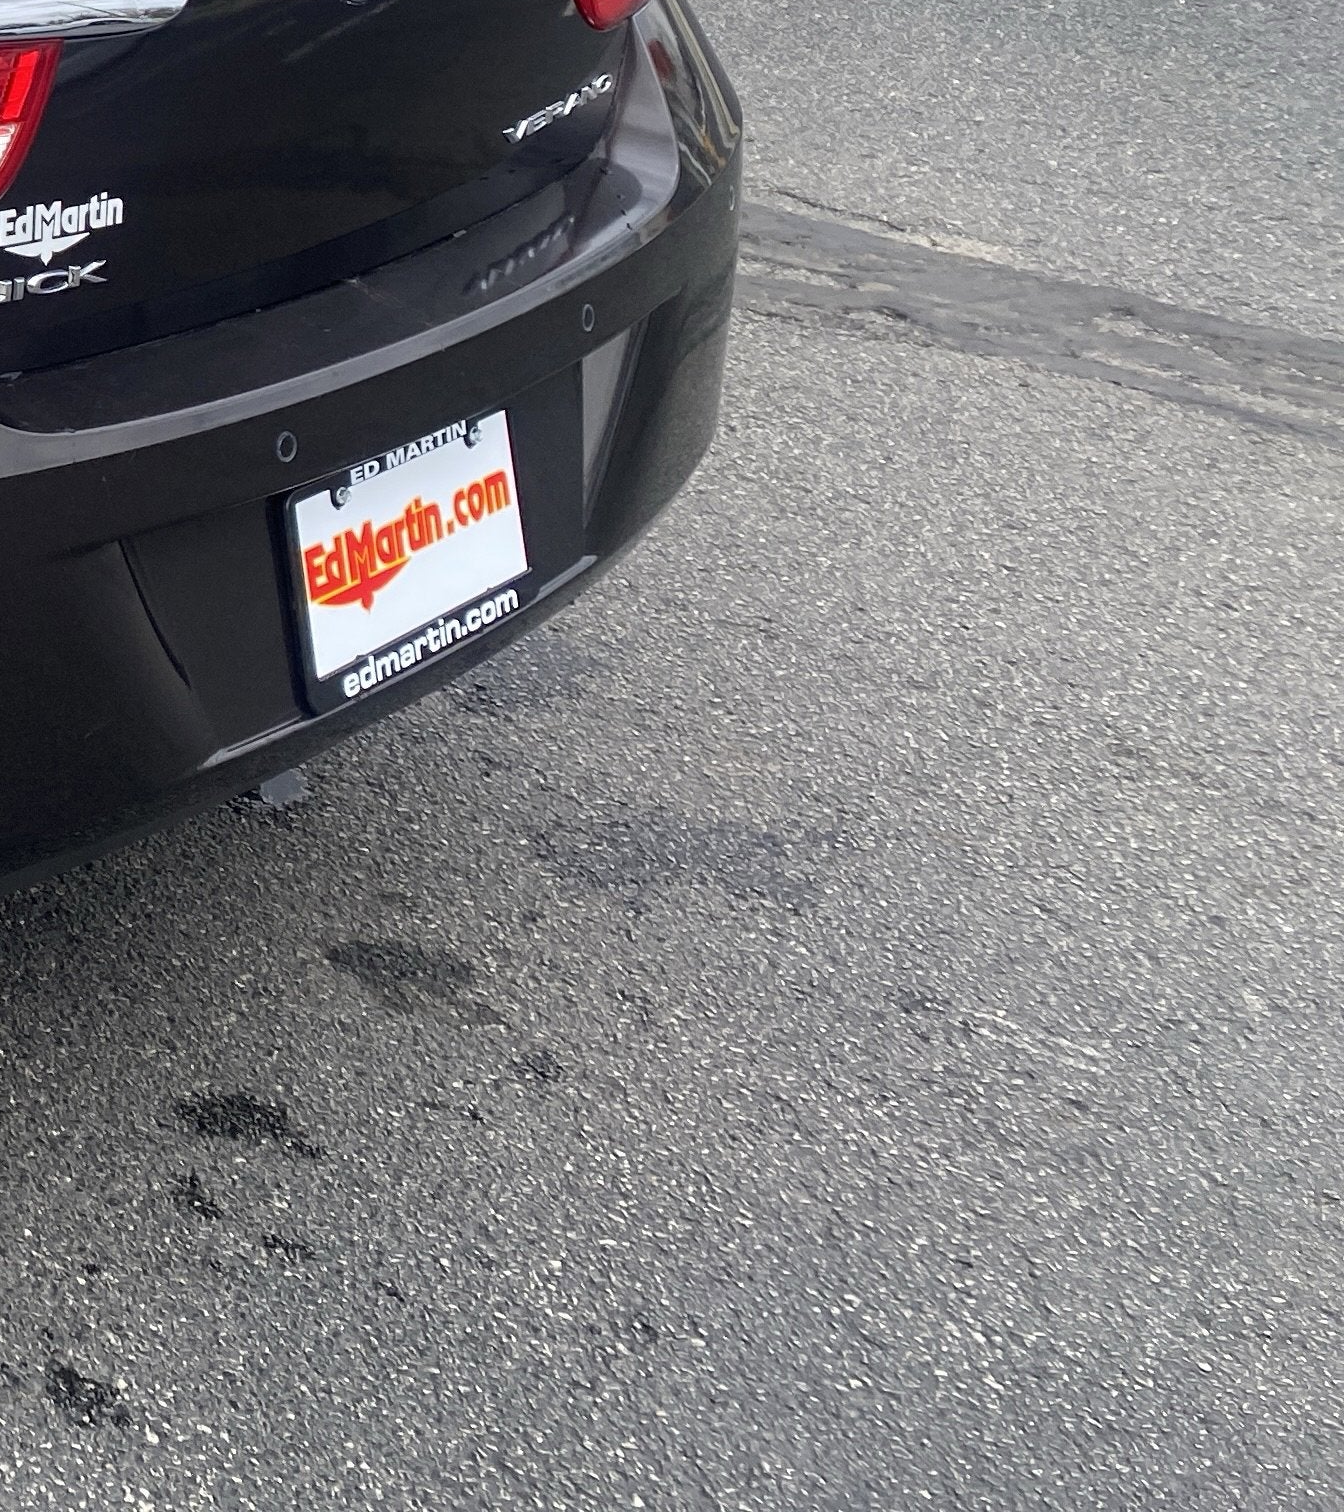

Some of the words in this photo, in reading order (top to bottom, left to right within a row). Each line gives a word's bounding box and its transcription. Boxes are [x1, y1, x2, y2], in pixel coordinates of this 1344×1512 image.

[502, 72, 612, 144] VERANO
[350, 460, 381, 486] ED
[386, 419, 468, 471] MARTIN
[304, 468, 512, 596] EdMartin.com
[343, 588, 520, 698] edmartin.com
